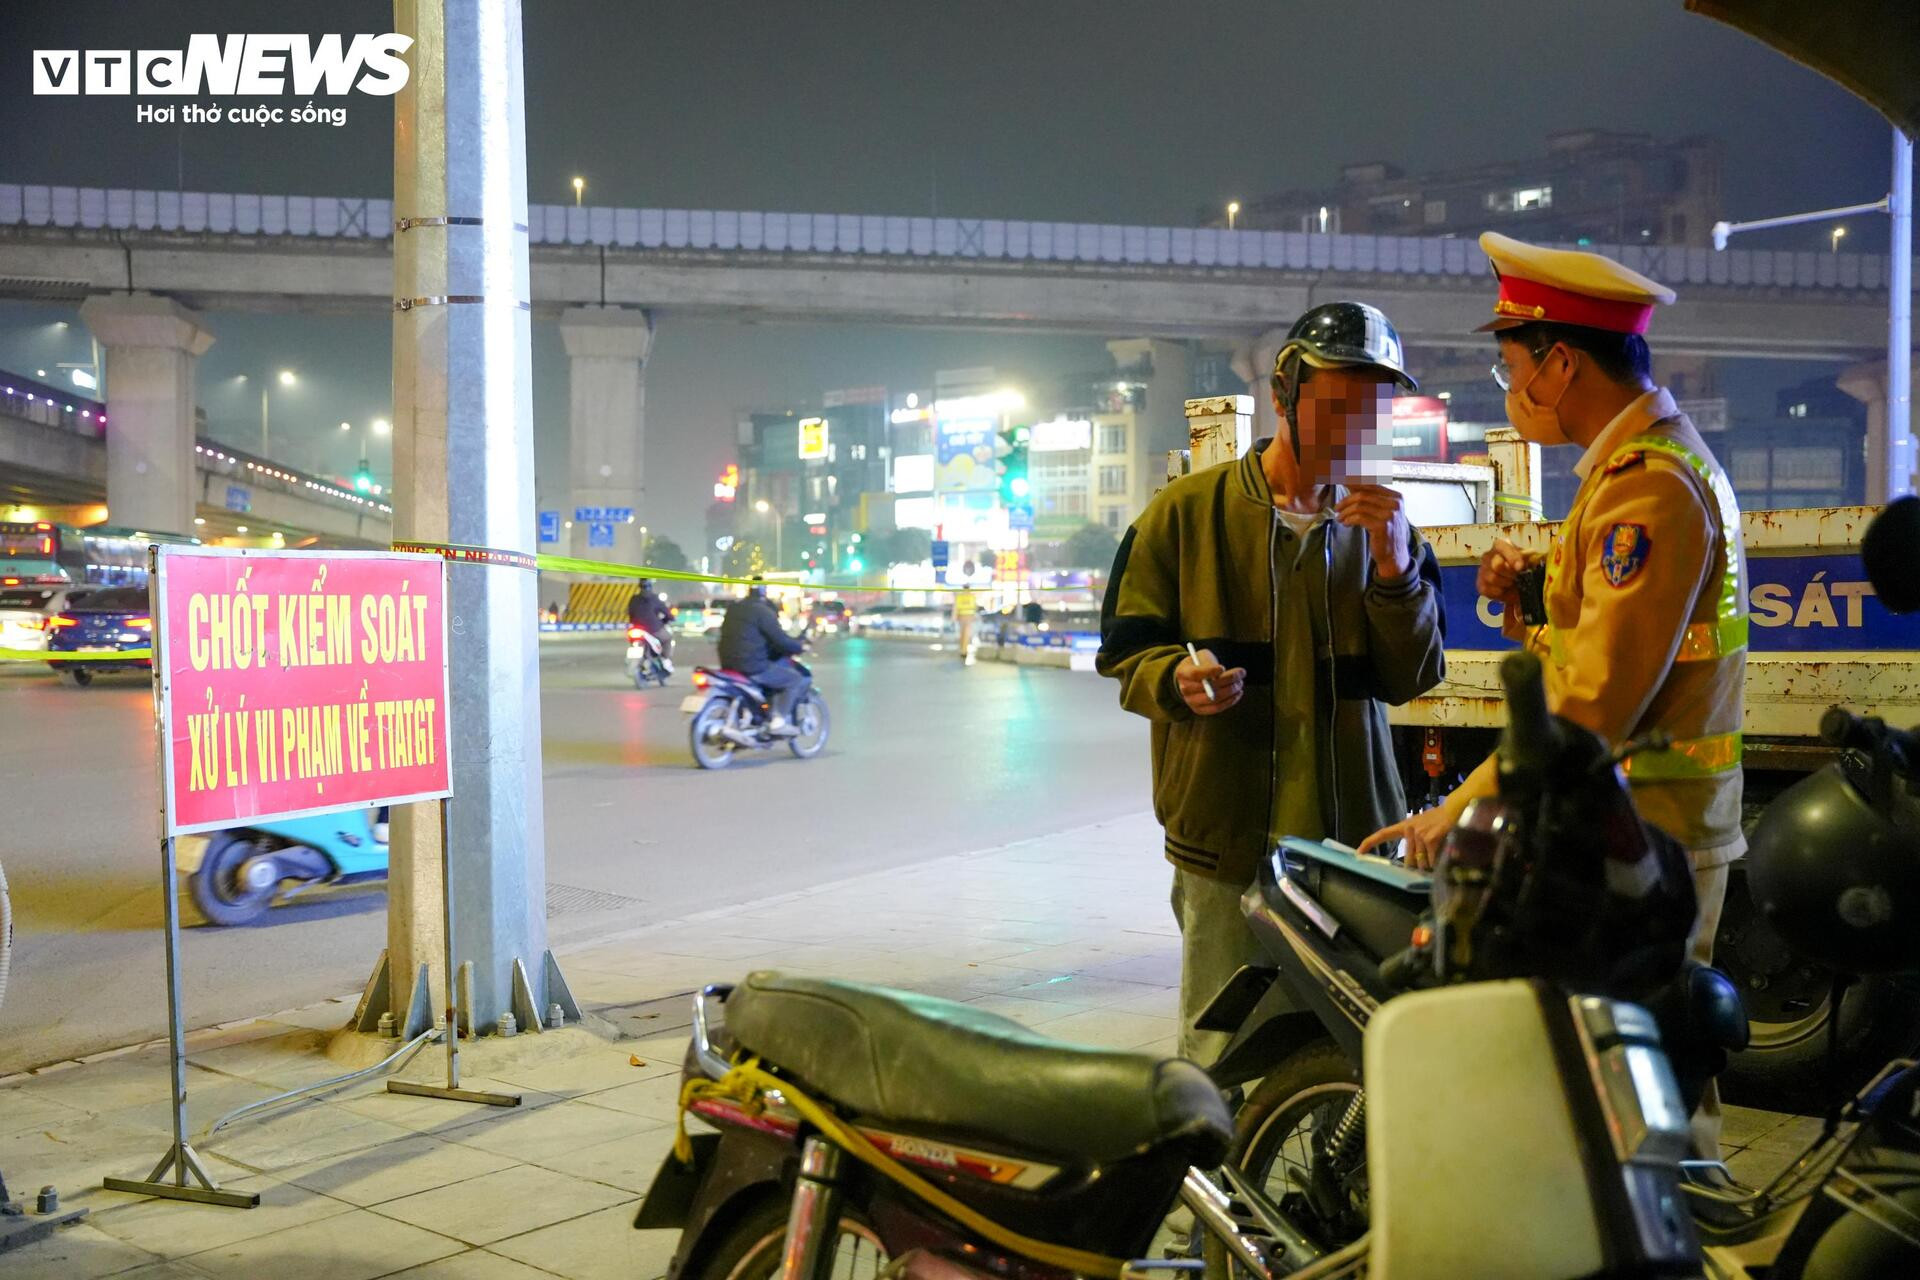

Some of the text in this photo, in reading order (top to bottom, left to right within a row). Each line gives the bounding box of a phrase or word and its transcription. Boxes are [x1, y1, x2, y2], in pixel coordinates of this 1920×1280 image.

[188, 564, 428, 672] CHỐT KIỂM SOÁT
[1749, 571, 1879, 628] SÁT
[187, 679, 435, 794] XỬ LÝ VI PHẠM VỀ TTATGT
